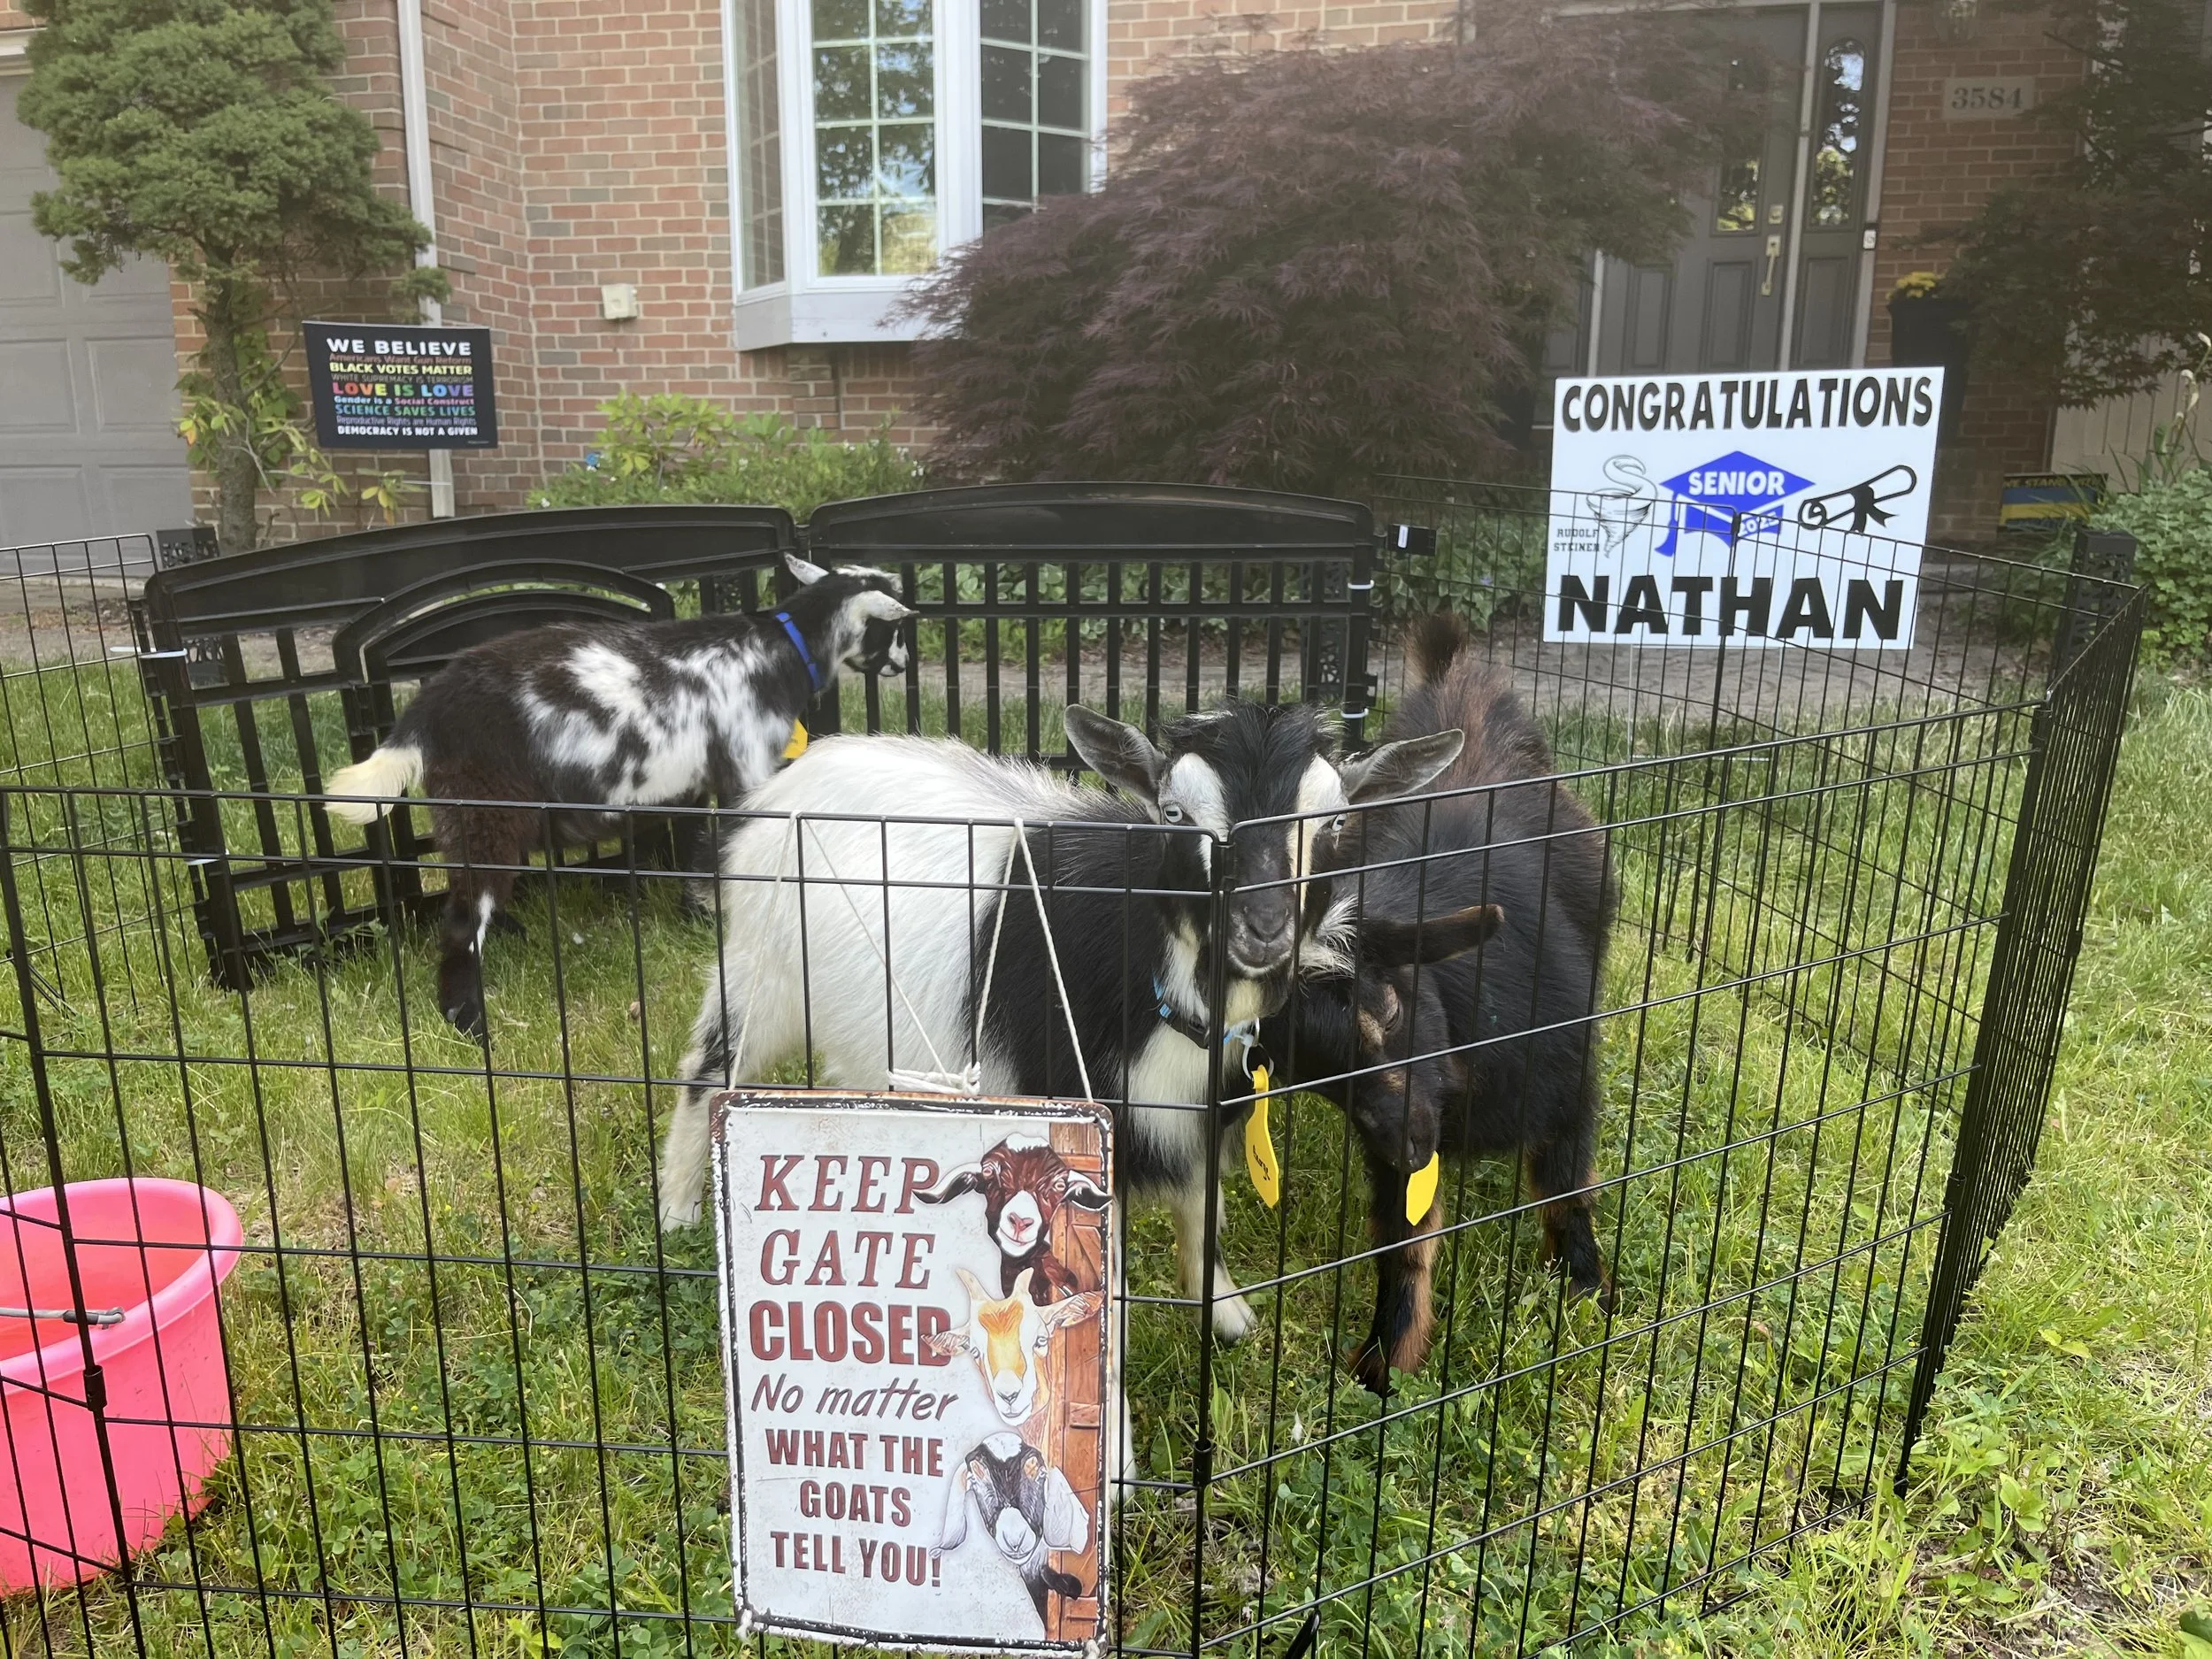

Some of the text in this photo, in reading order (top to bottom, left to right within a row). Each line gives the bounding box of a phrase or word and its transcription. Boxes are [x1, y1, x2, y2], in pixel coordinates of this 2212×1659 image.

[1951, 88, 2023, 109] 3584
[326, 338, 472, 356] WE BELIEVE
[329, 354, 382, 364] Americans
[329, 362, 472, 375] BLACK VOTES MATTER
[332, 373, 358, 382] WHITE
[362, 373, 412, 383] SUPREMACY
[427, 375, 473, 384] TERRORISM
[332, 381, 474, 397] LOVE IS LOVE
[335, 403, 476, 416] SCIENCE SAVES LIVES
[1562, 376, 1933, 433] CONGRATULATIONS
[336, 415, 385, 426] Reproductive
[387, 417, 411, 426] Rights
[453, 418, 476, 427] Rights
[337, 426, 478, 436] DEMOCRACY IS NOT A GIVEN
[1688, 471, 1786, 496] SENIOR
[1557, 528, 1600, 538] RUDOLF
[1554, 542, 1600, 552] STEINER
[1557, 574, 1903, 641] NATHAN
[754, 1154, 940, 1215] KEEP
[760, 1228, 936, 1290] GATE
[749, 1299, 952, 1367] CLOSED
[750, 1372, 959, 1422] No matter
[764, 1428, 944, 1478] WHAT THE
[799, 1479, 912, 1528] GOATS
[770, 1531, 941, 1588] TELL YOU!
